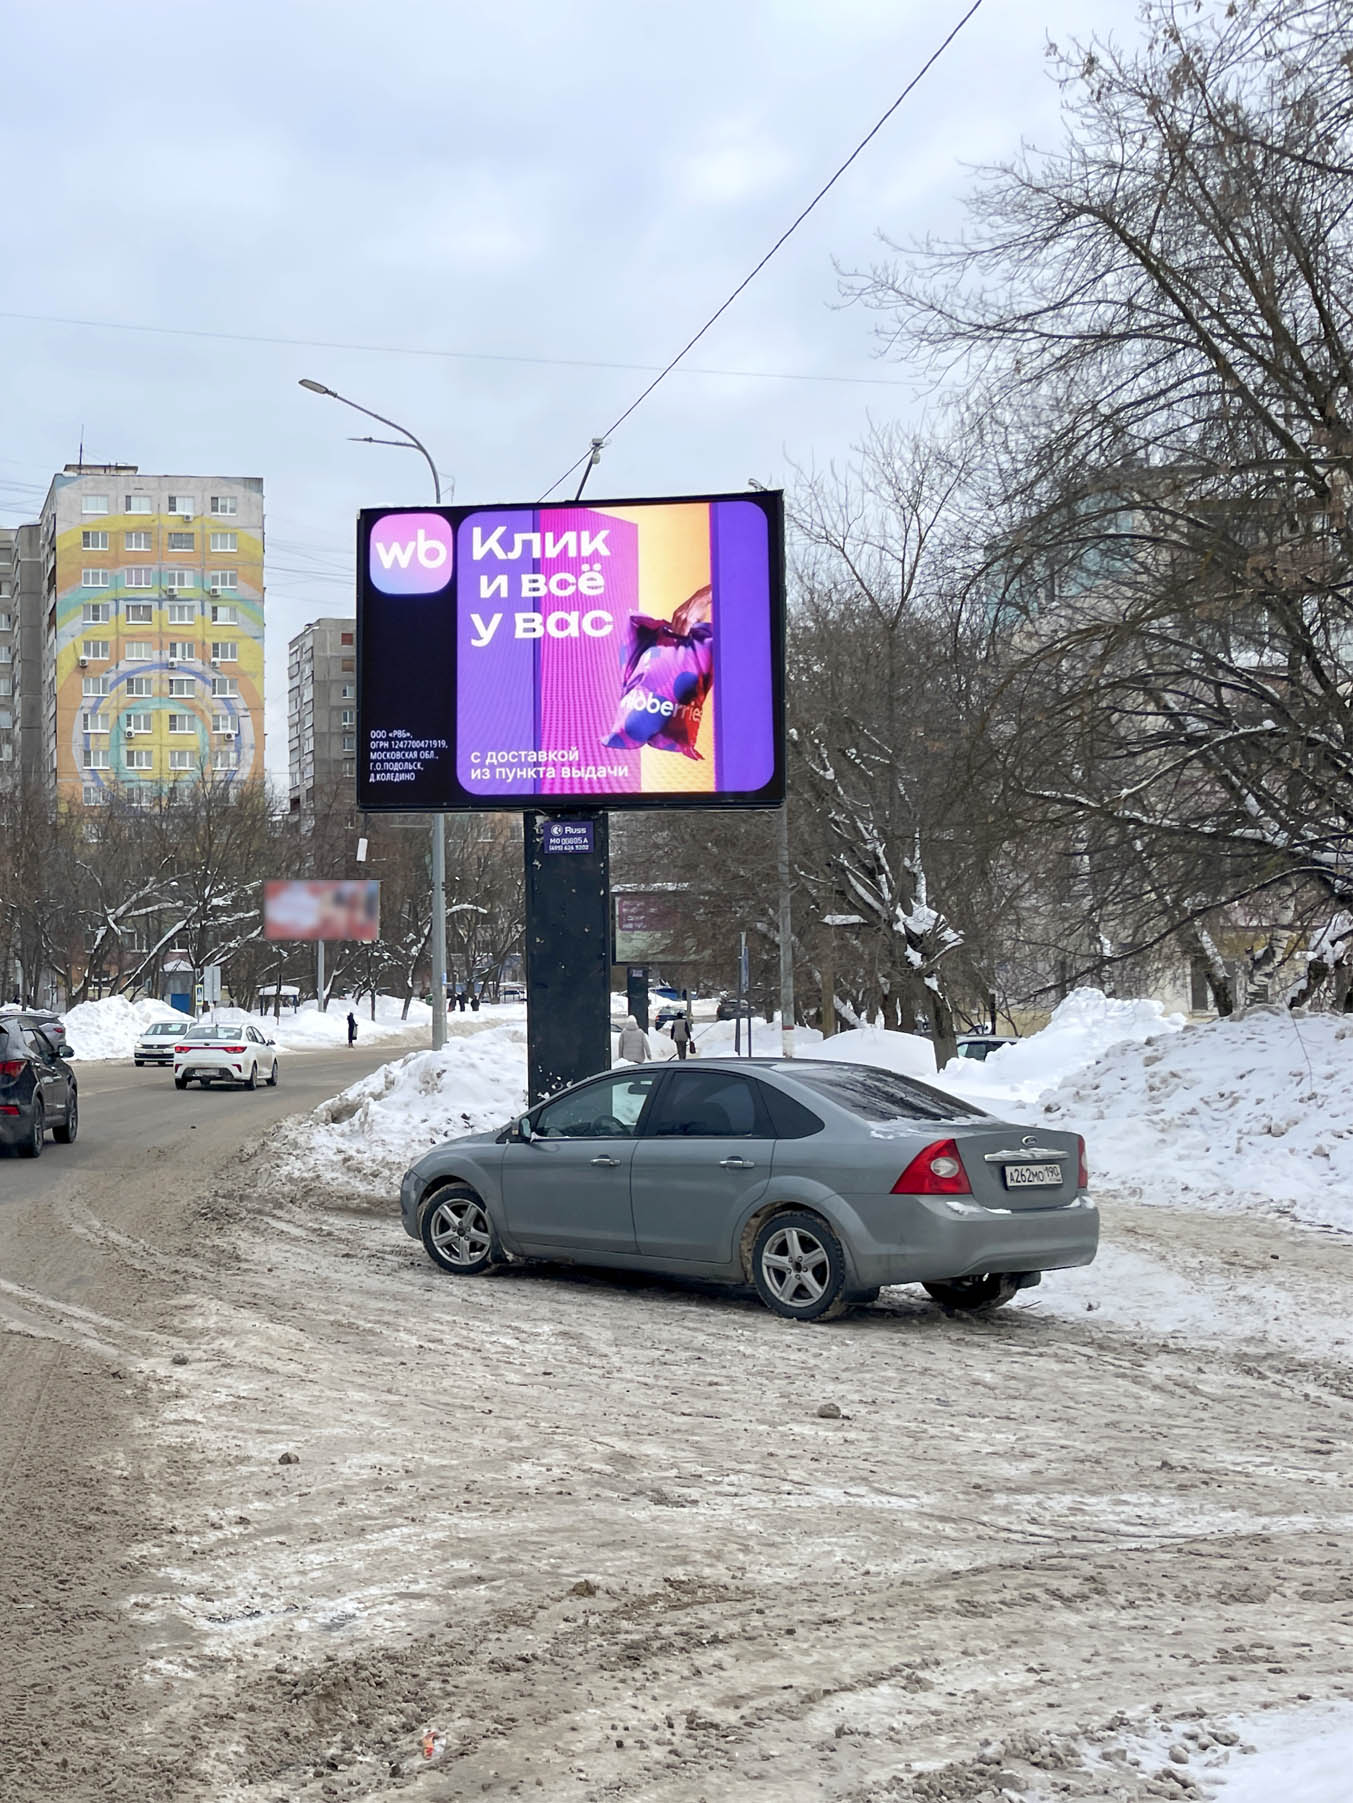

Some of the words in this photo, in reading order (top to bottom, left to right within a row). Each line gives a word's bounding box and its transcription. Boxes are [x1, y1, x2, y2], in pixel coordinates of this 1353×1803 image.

[376, 528, 447, 568] wb
[472, 526, 611, 560] Клик
[480, 574, 508, 598] и
[520, 563, 605, 597] всё
[470, 613, 503, 647] у
[514, 609, 614, 639] вас
[370, 730, 387, 739] ООО
[370, 741, 389, 749] ОГРН
[370, 751, 418, 760] МОСКОВСКАЯ
[471, 751, 481, 763] с
[485, 746, 579, 765] доставкой
[471, 768, 491, 780] из
[496, 767, 555, 783] пункта
[561, 765, 629, 783] выдачи
[565, 826, 586, 834] Russ
